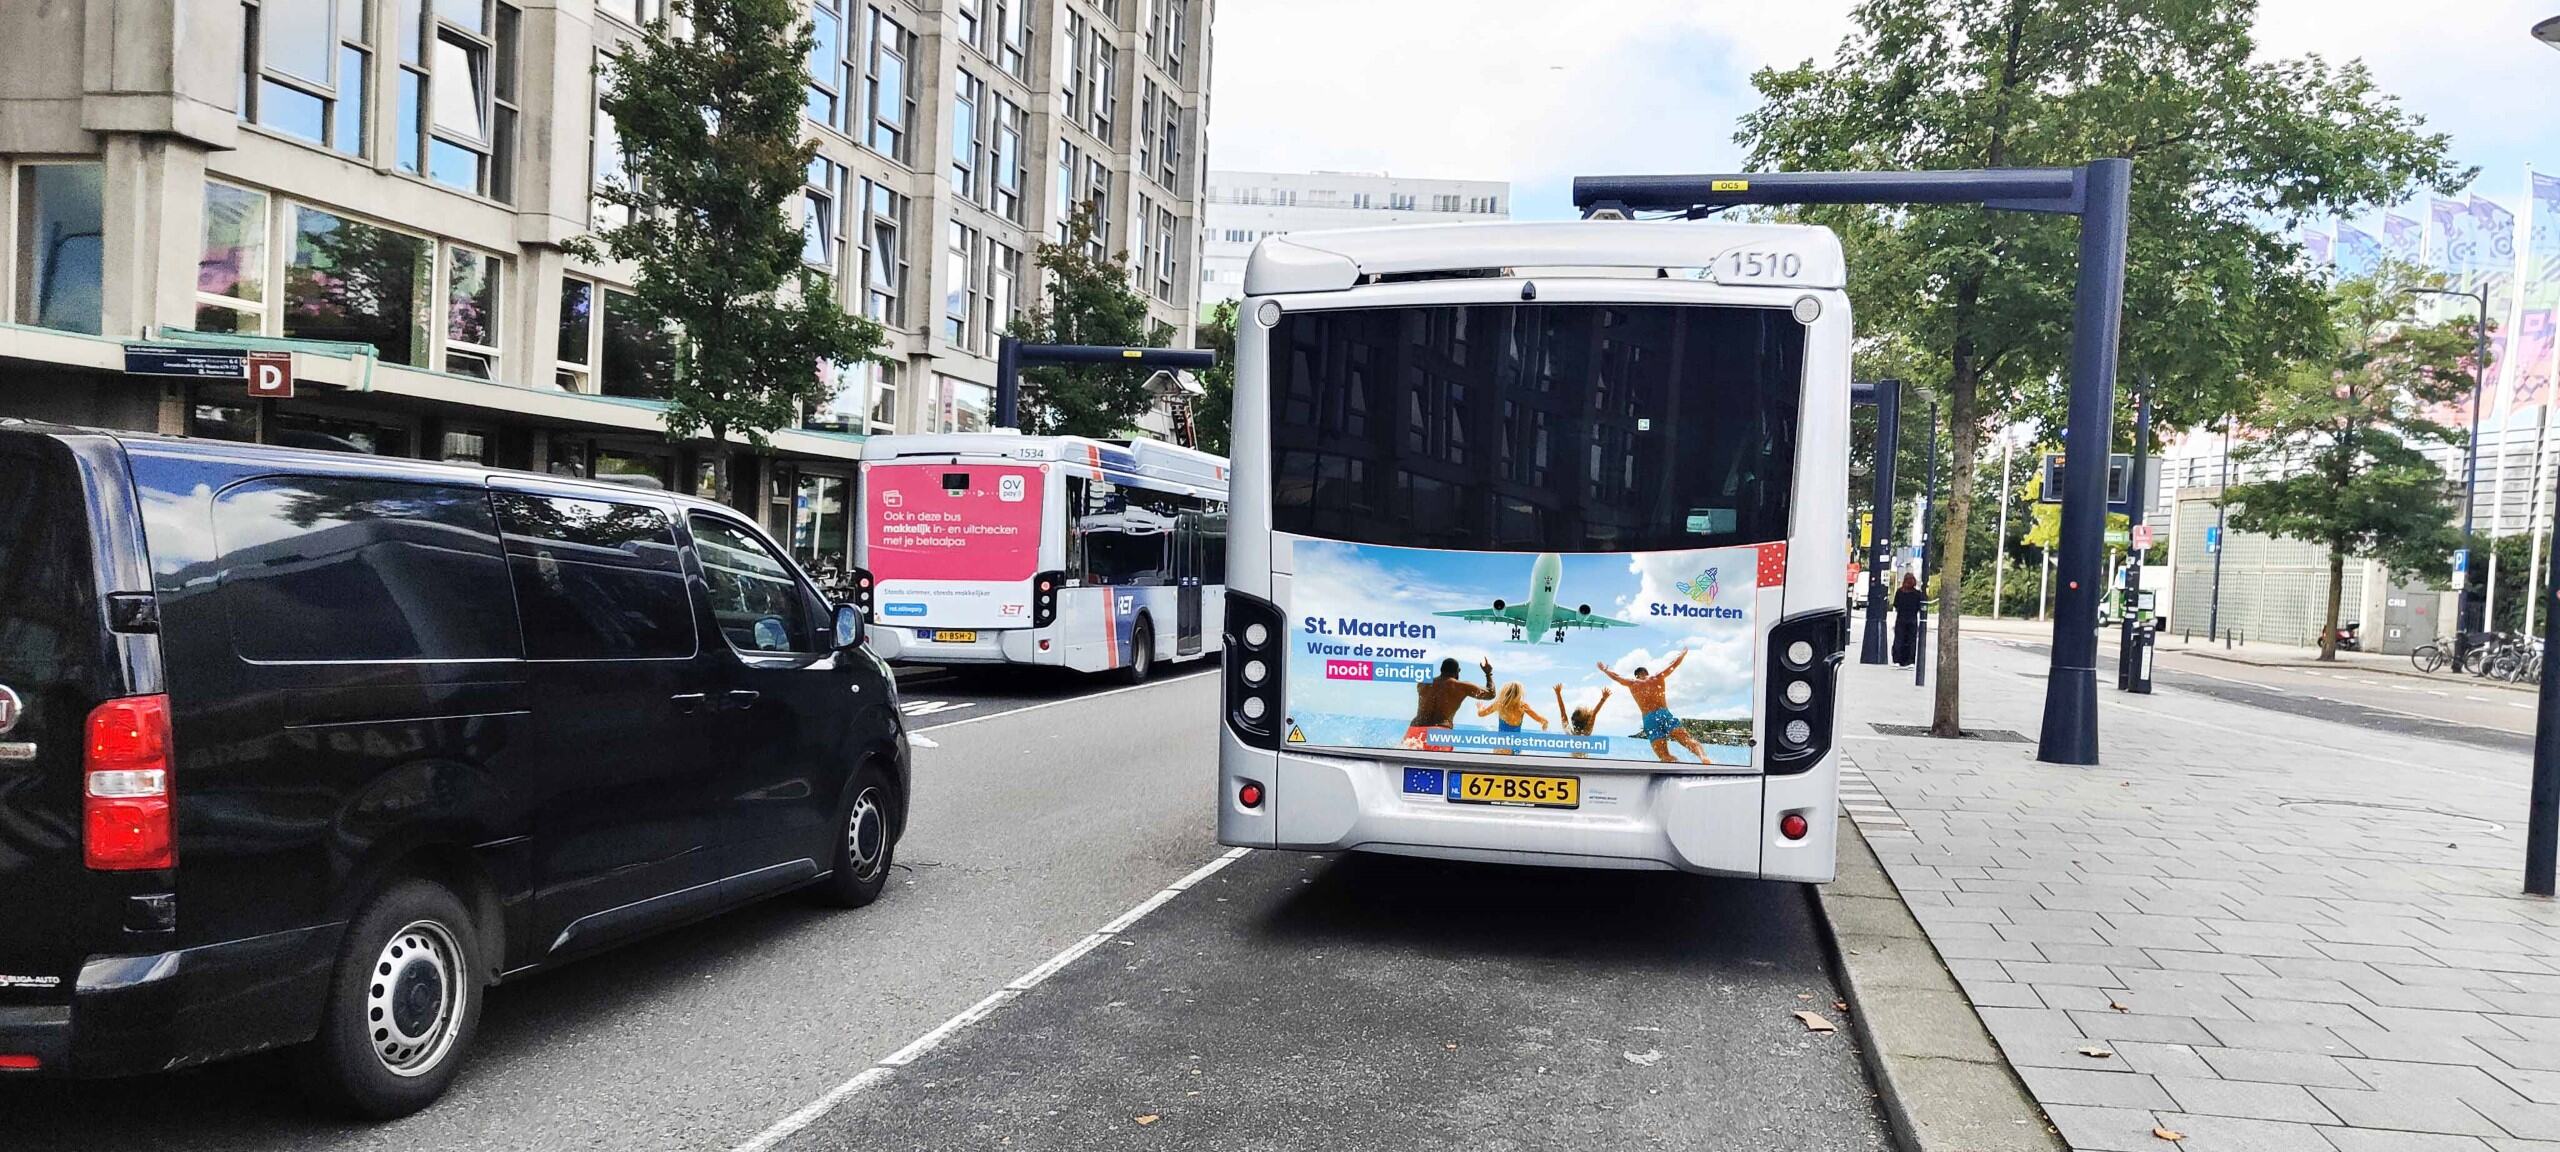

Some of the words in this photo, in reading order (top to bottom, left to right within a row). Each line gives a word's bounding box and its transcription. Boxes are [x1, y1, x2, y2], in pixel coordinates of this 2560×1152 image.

[1720, 182, 1739, 190] OC5
[1730, 251, 1801, 278] 1510
[259, 364, 282, 390] D
[1020, 448, 1044, 458] 1534
[1003, 479, 1021, 490] OV
[883, 511, 904, 521] Ook
[906, 511, 915, 521] in
[917, 512, 941, 522] deze
[943, 511, 962, 522] bus
[883, 523, 931, 535] makkelijk
[947, 525, 961, 535] en
[963, 524, 1018, 535] uitchecken
[883, 535, 902, 545] met
[903, 536, 914, 547] je
[916, 536, 966, 548] betaalpas
[2455, 552, 2463, 570] P
[1001, 604, 1025, 615] RET
[1650, 602, 1671, 616] St.
[1673, 604, 1743, 619] Maarten
[1304, 616, 1333, 635] St.
[1338, 618, 1436, 639] Maarten
[1307, 642, 1350, 656] Waar
[1353, 644, 1373, 657] de
[1376, 647, 1426, 659] zomer
[1328, 663, 1369, 677] nooit
[1375, 664, 1432, 682] eindigt
[1429, 733, 1607, 750] www.vakantiestmaarten.nl
[1468, 777, 1569, 800] 67-BSG-5
